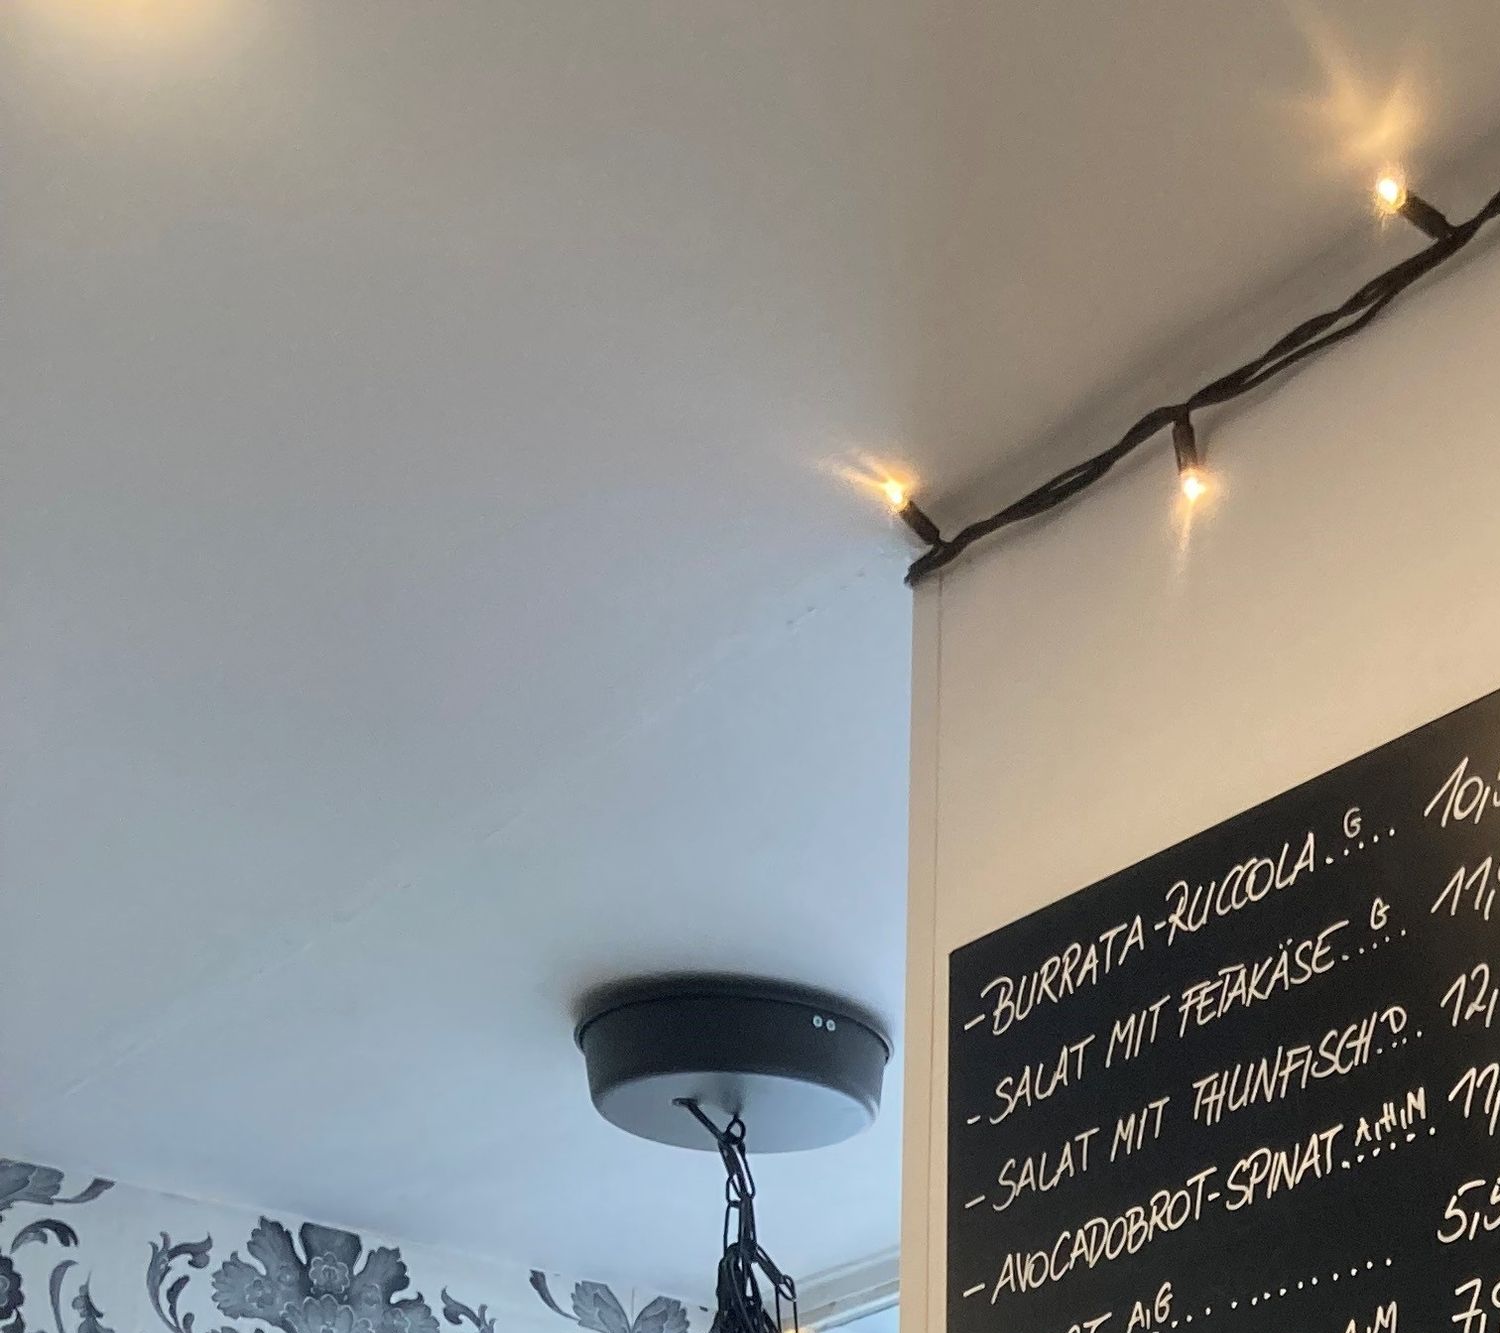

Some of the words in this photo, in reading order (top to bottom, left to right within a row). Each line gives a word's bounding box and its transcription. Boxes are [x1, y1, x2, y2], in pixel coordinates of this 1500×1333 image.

[993, 1034, 1096, 1123] SALAT
[1106, 996, 1169, 1069] MIT
[1178, 920, 1349, 1037] FETAKÄSE
[994, 1129, 1099, 1210] SALAT
[1111, 1099, 1171, 1163] MIT
[1192, 1013, 1376, 1126] THUNFISCH
[993, 1124, 1341, 1304] AVOCADOBROT-SPINAT
